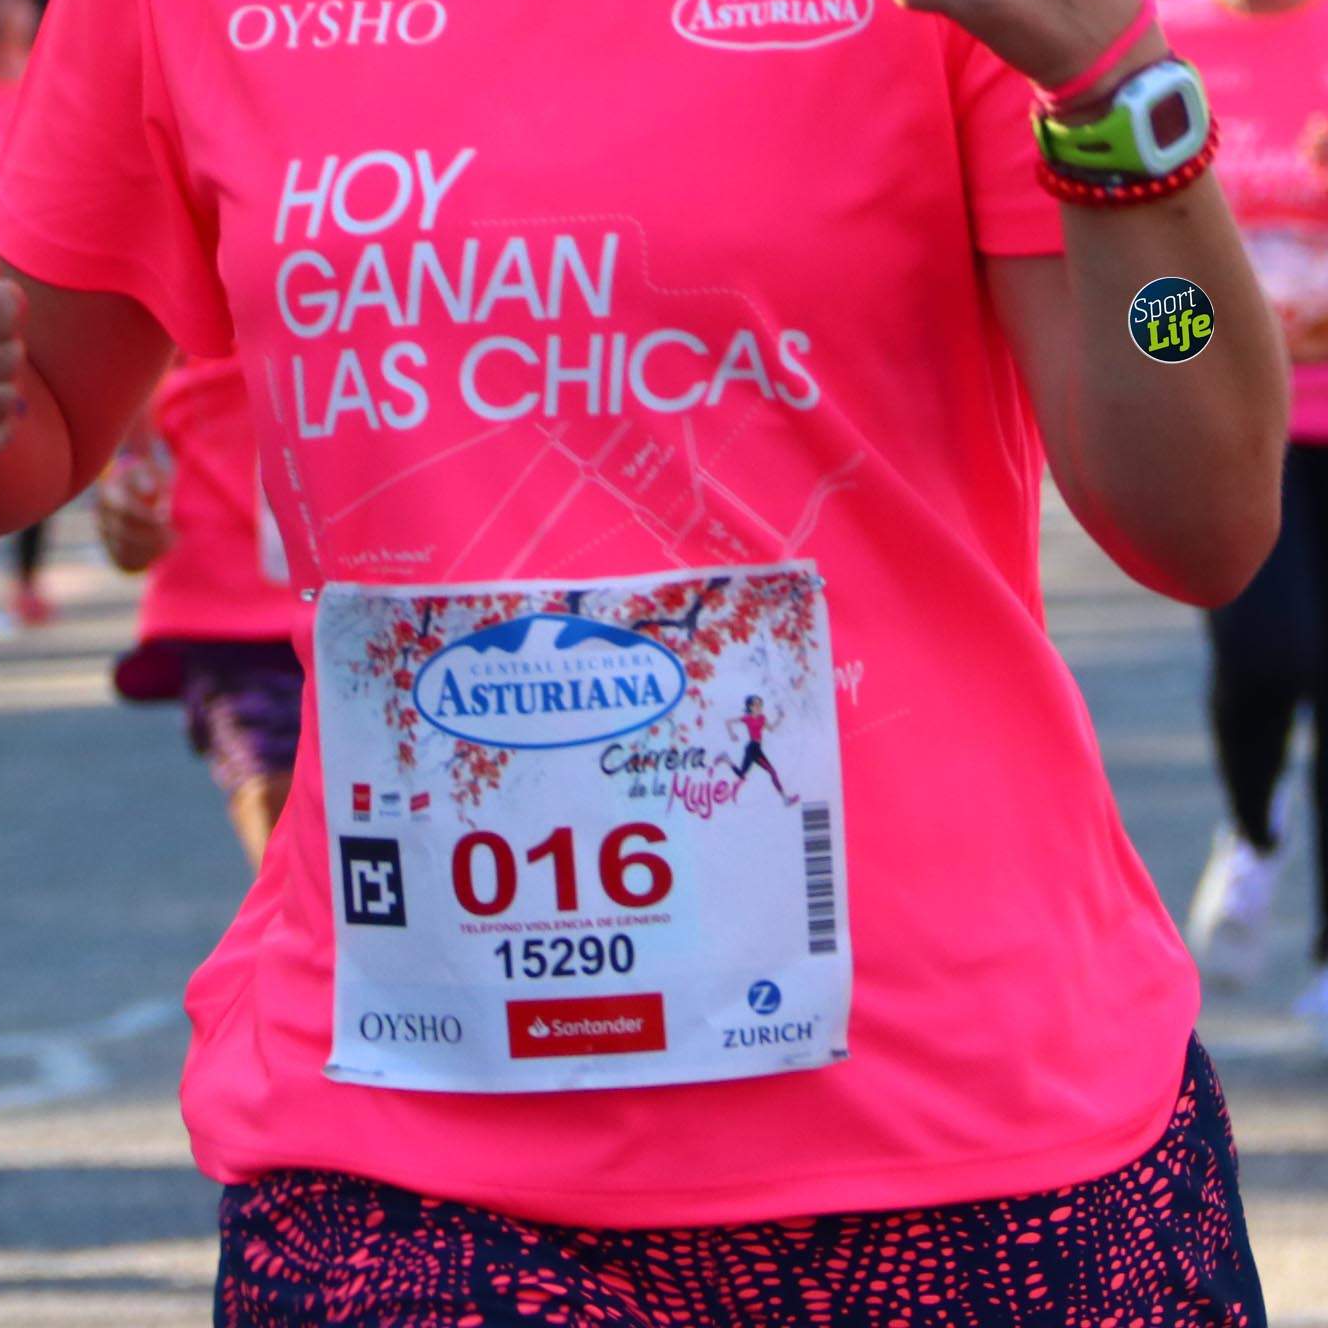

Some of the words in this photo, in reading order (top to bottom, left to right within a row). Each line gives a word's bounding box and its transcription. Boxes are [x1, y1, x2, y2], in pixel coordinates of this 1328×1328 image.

[274, 148, 477, 243] HOY
[276, 233, 618, 338] GANAN
[292, 341, 430, 439] LAS
[460, 329, 820, 421] CHICAS
[470, 660, 552, 675] CENTRAL
[435, 668, 665, 717] ASTURIANA
[600, 743, 706, 775] Carrera
[629, 777, 650, 798] de
[668, 771, 745, 821] Mujer
[451, 822, 674, 917] 016
[494, 933, 635, 979] 15290
[359, 1012, 463, 1044] OYSHO
[550, 1015, 645, 1037] Santander
[723, 1022, 813, 1048] ZURICH
